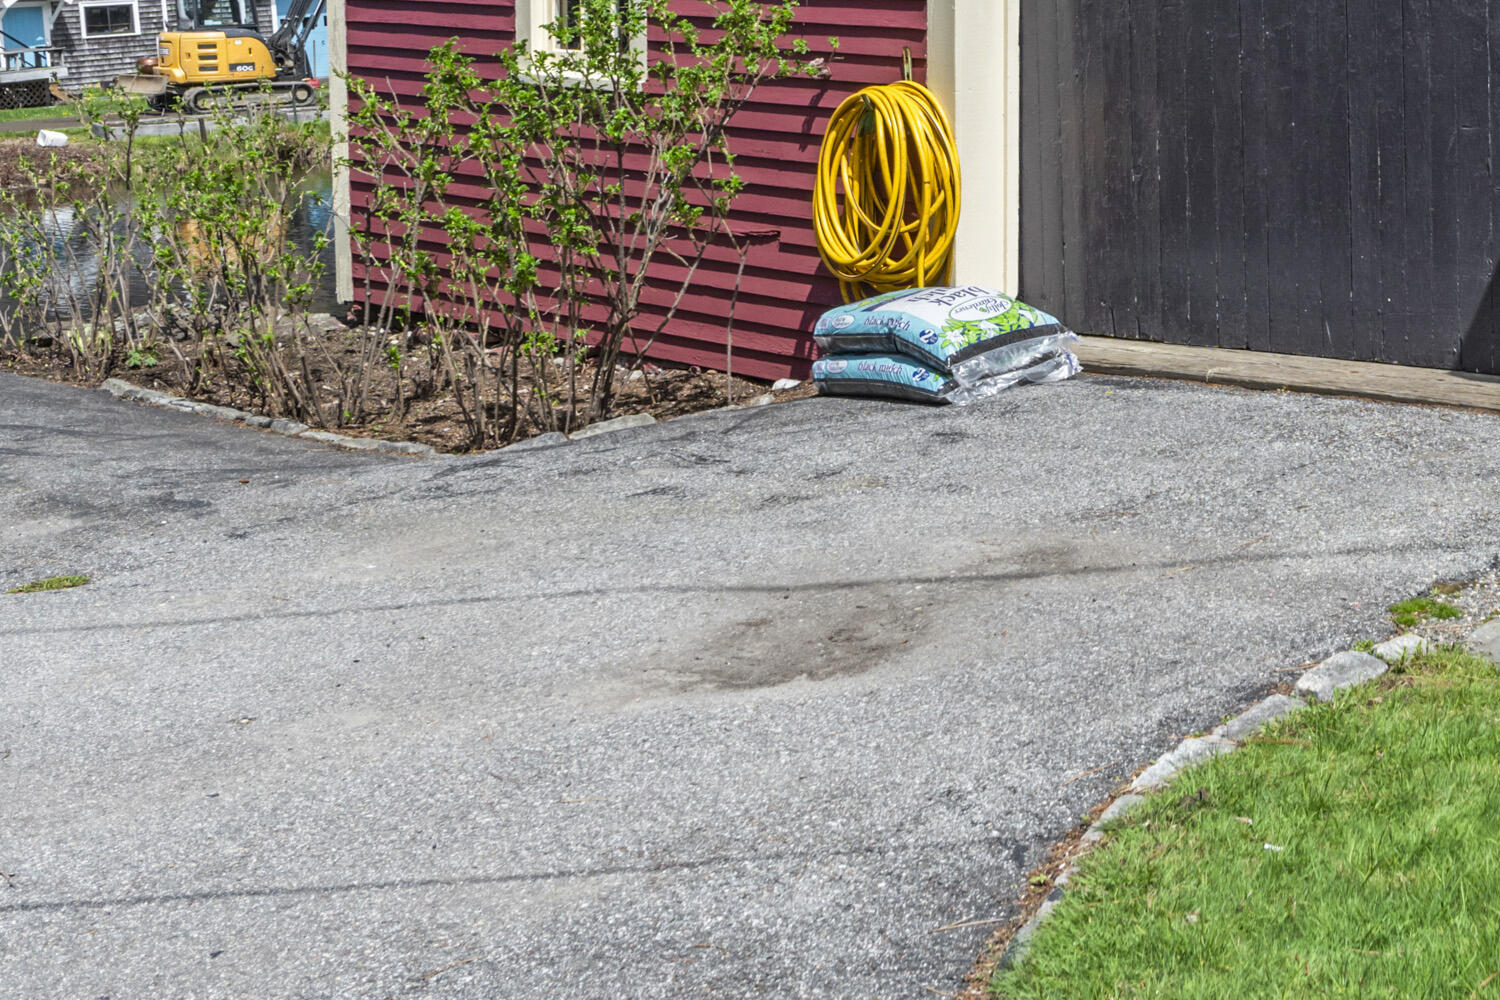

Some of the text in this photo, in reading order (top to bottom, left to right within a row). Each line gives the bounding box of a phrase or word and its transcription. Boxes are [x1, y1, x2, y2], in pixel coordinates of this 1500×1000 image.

[927, 285, 990, 307] black
[954, 298, 998, 314] Gardener
[986, 300, 1010, 314] Jolly
[864, 315, 884, 326] black
[858, 360, 876, 371] black
